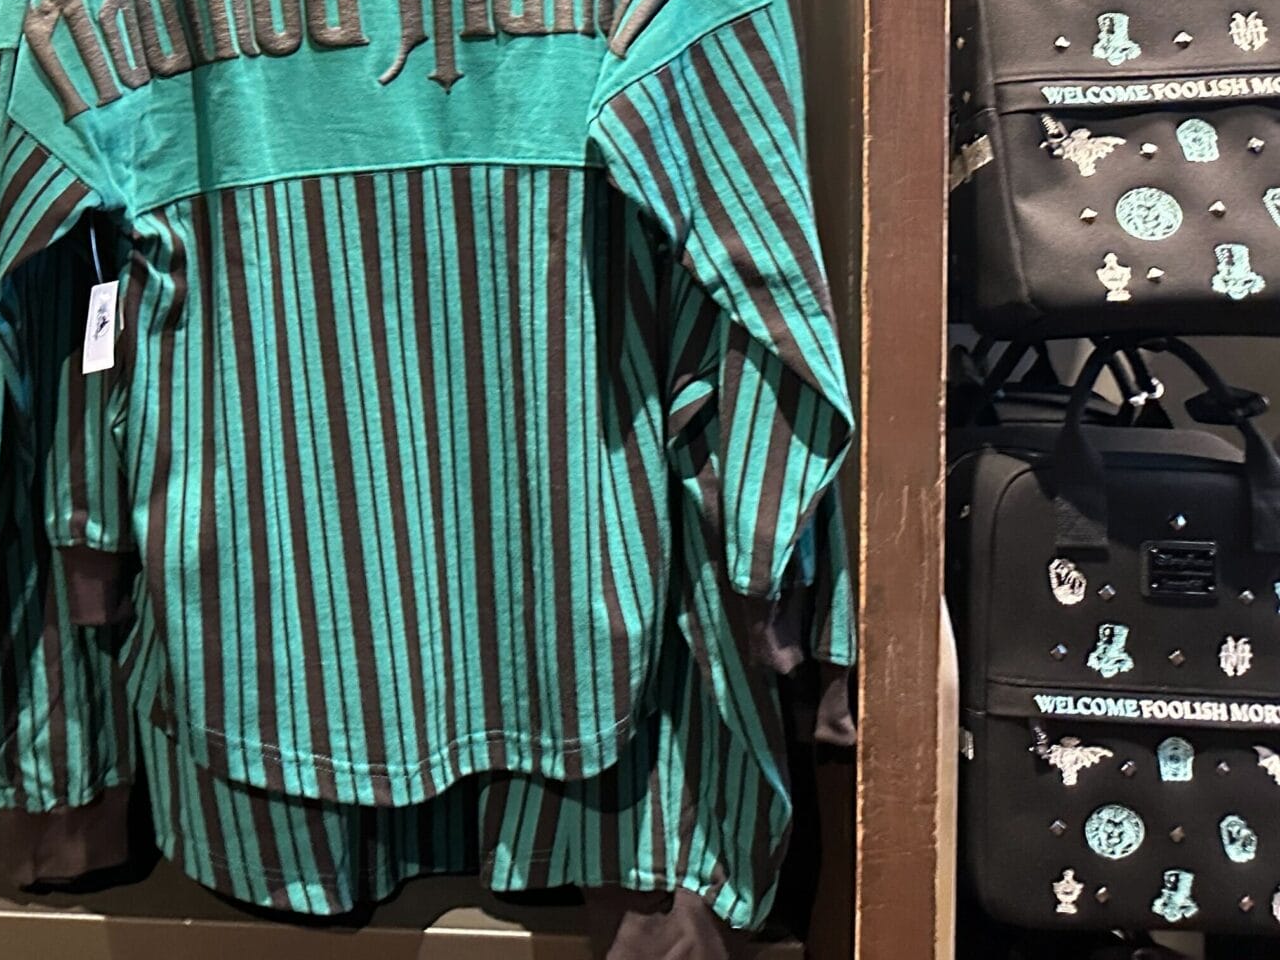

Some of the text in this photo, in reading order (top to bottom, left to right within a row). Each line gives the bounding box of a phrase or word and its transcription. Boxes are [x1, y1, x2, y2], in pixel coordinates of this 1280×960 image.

[1041, 84, 1151, 105] WELCOME
[1151, 77, 1250, 101] FOOLISH
[1033, 694, 1280, 724] WELCOME FOOLISH MOR
